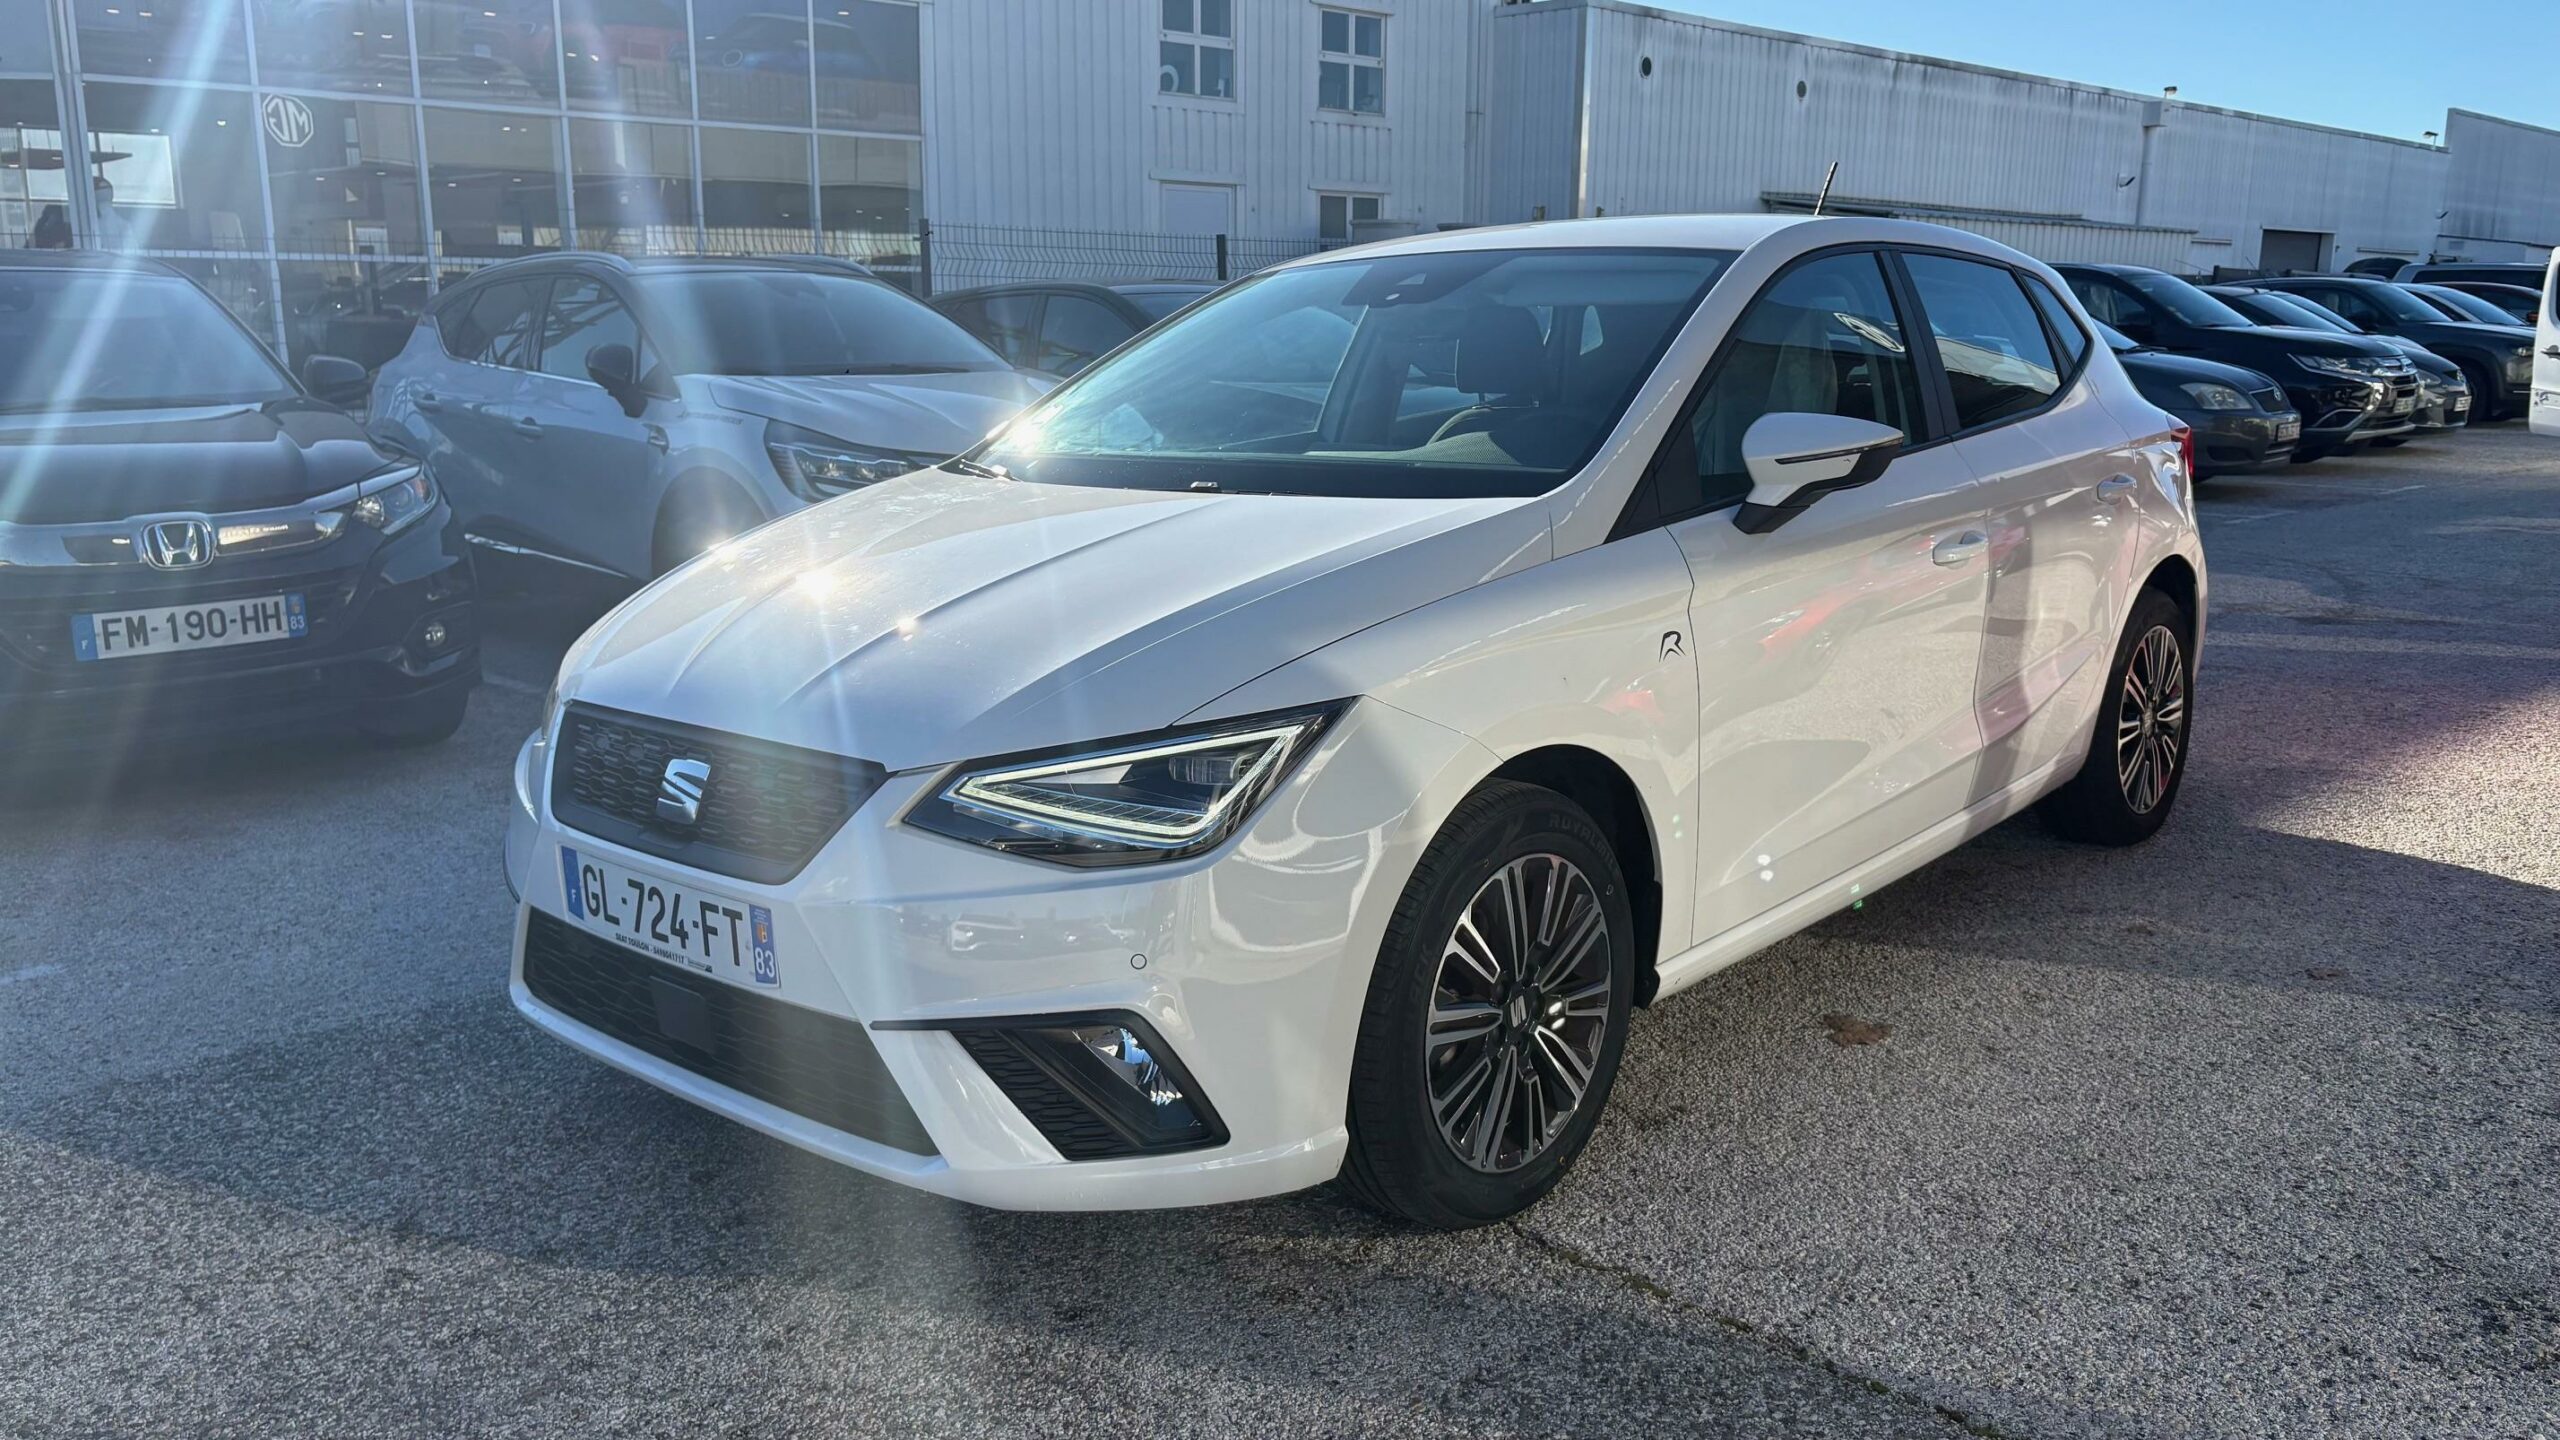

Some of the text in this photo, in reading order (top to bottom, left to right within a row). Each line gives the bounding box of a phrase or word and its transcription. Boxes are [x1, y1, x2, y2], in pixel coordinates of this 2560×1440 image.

[101, 601, 282, 651] FM-190-HH
[289, 615, 304, 630] 83
[570, 888, 577, 903] F
[582, 864, 743, 967] GL-724-FT
[754, 947, 775, 978] 83
